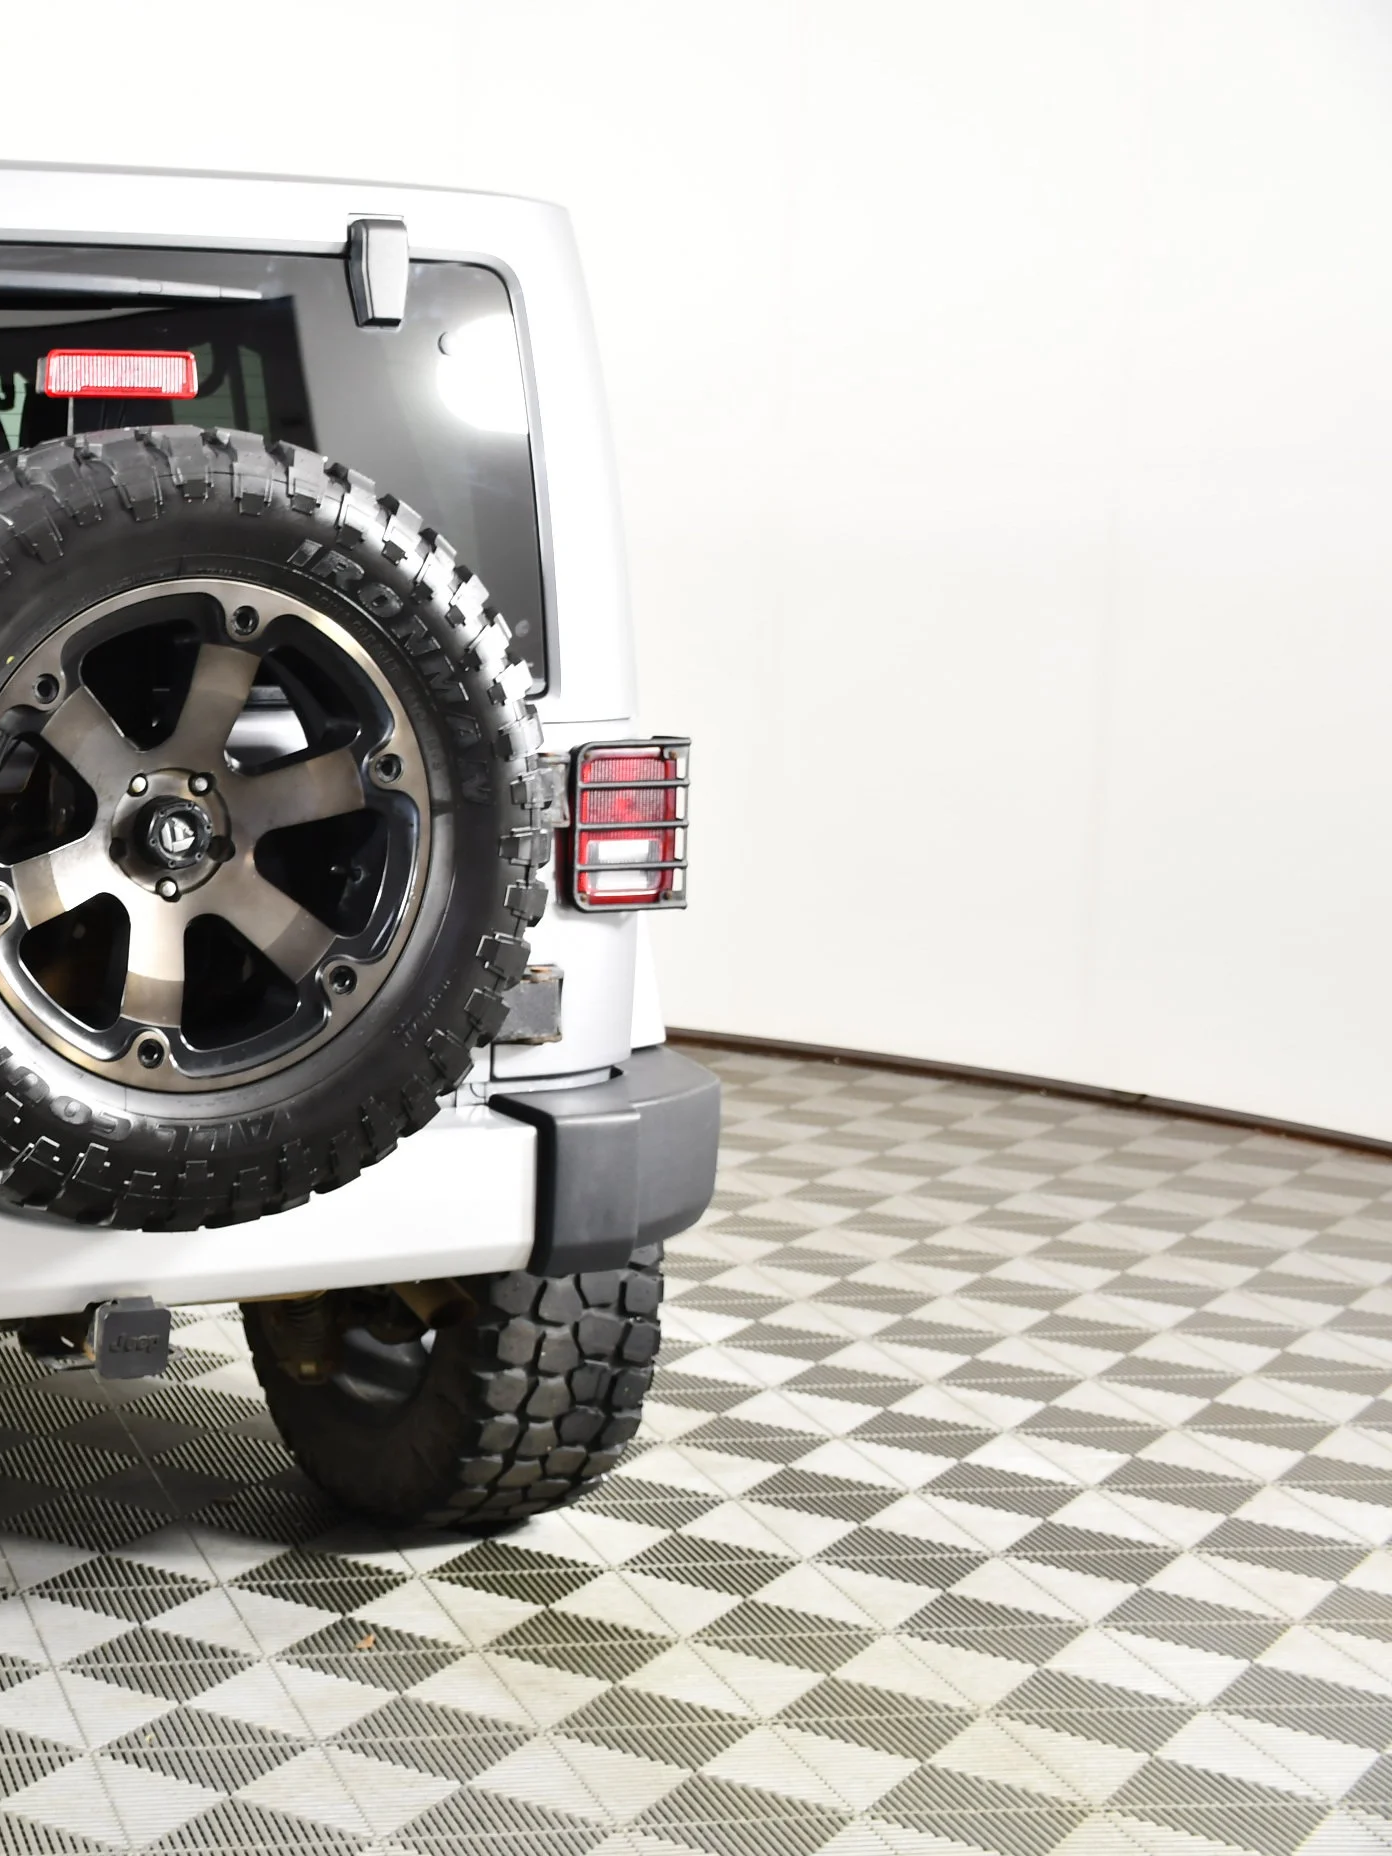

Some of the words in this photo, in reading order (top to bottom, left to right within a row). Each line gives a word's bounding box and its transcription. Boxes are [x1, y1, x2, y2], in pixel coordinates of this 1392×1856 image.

[287, 538, 496, 805] IRONMAN
[154, 1110, 278, 1153] ALL
[109, 1333, 160, 1354] Jeep
